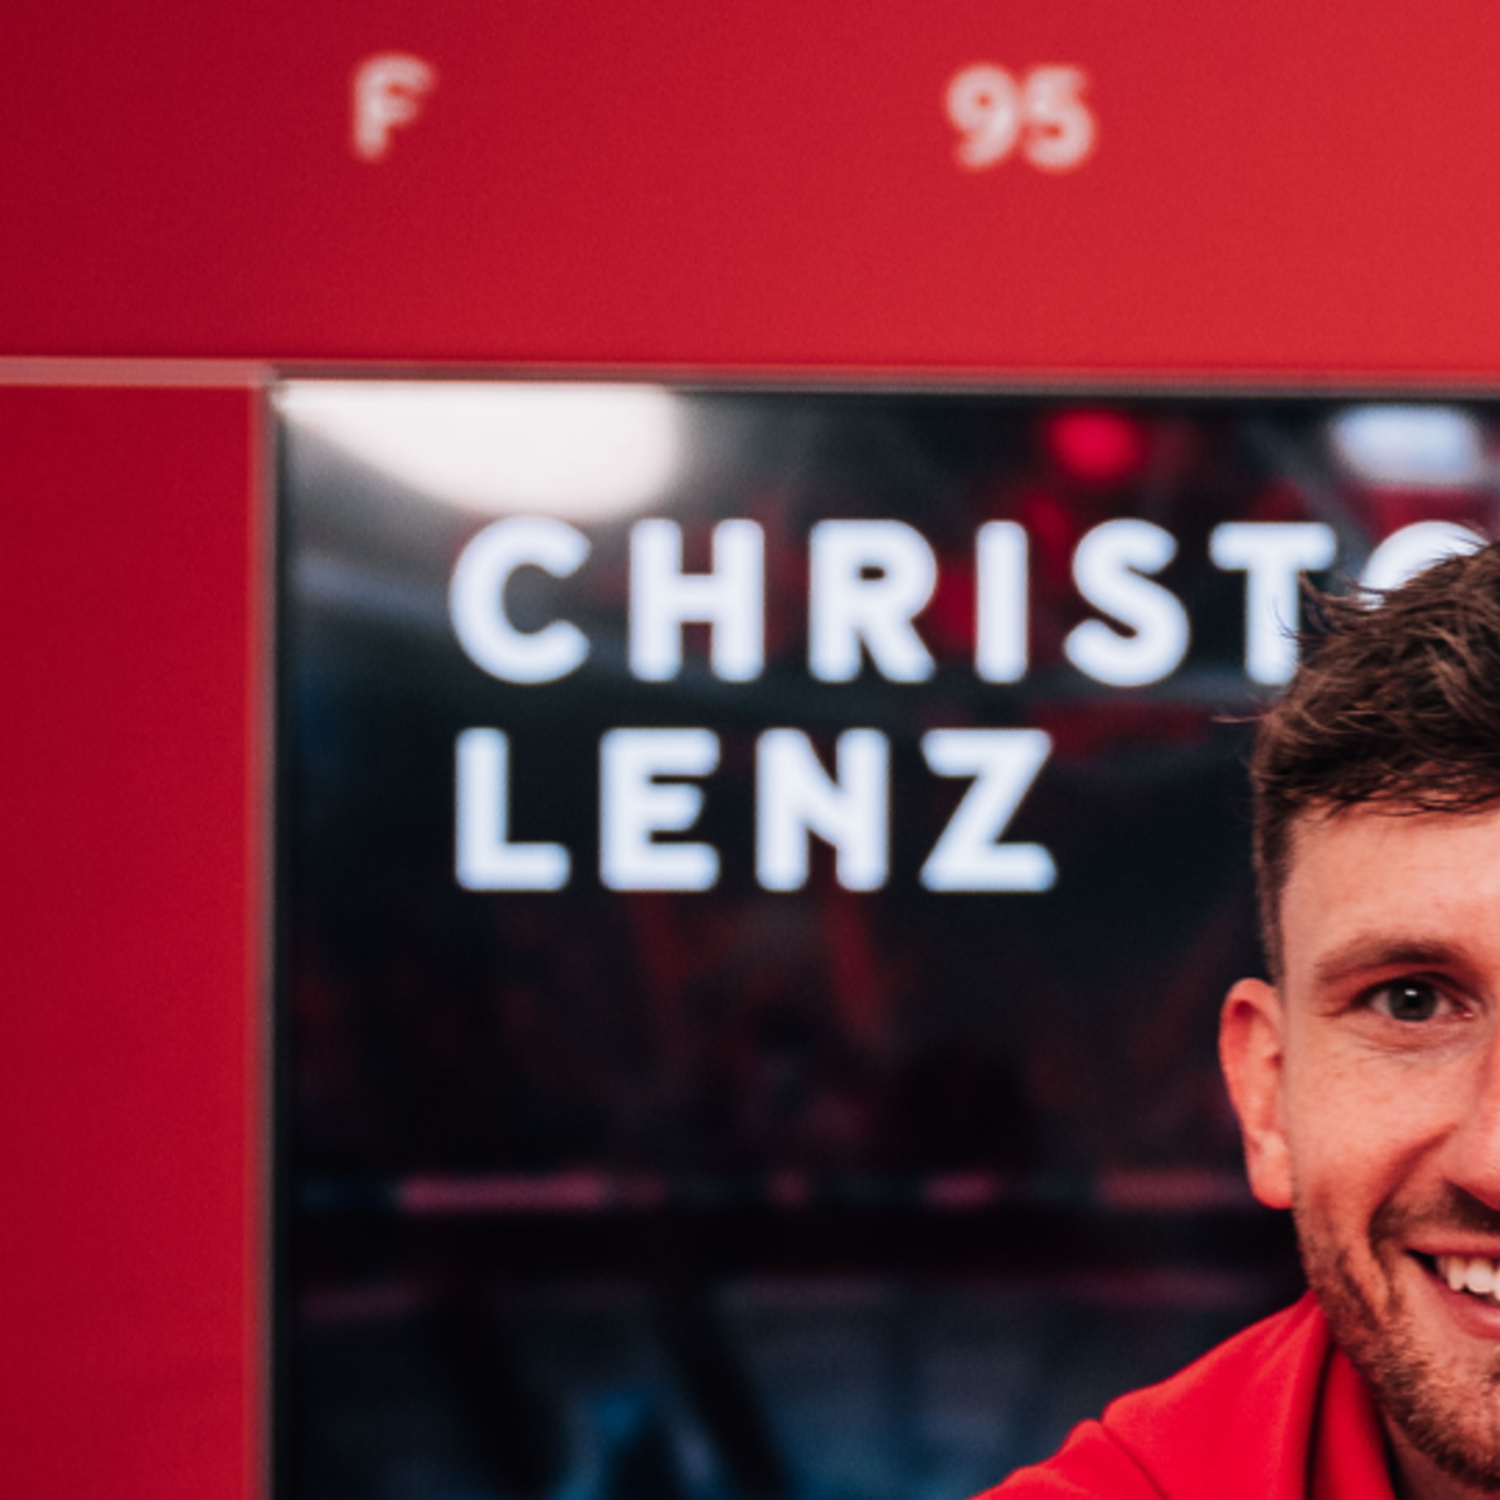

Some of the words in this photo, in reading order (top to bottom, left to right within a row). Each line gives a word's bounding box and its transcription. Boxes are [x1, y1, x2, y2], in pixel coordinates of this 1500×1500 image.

[352, 53, 435, 161] F
[945, 62, 1096, 169] 95
[455, 727, 1057, 892] LENZ
